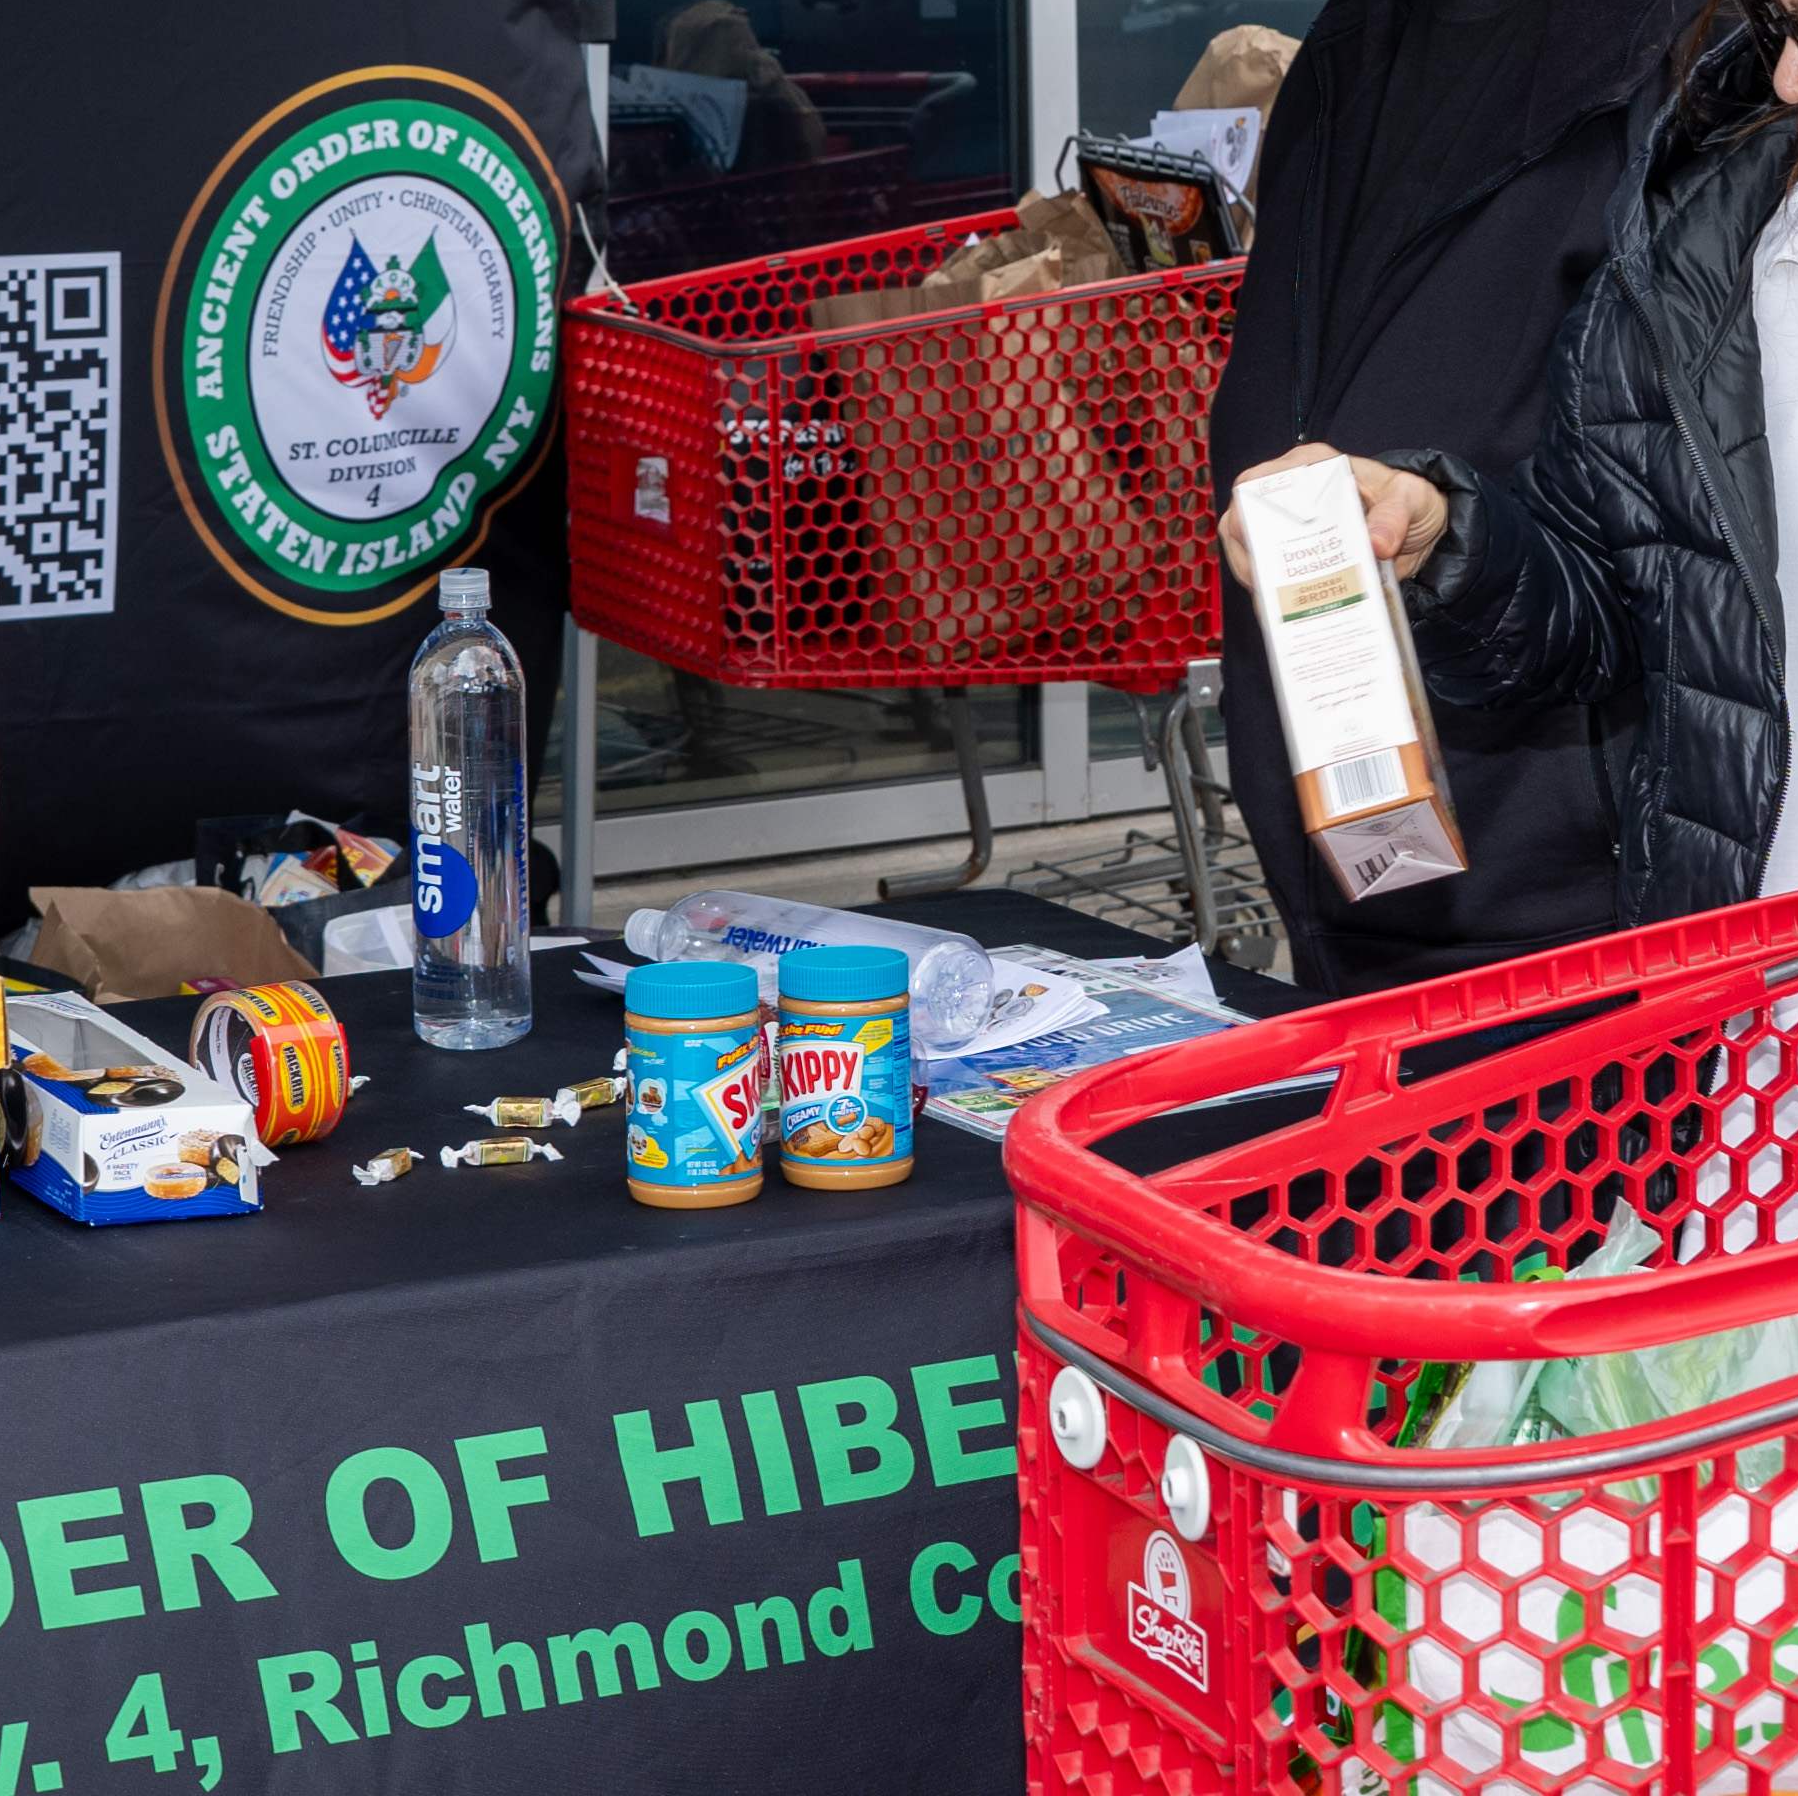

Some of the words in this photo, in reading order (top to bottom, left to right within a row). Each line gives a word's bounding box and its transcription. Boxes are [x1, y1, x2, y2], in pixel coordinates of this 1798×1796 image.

[196, 195, 271, 400] ANCIENT
[270, 119, 400, 199] ORDER
[408, 119, 459, 154] OF
[458, 136, 559, 373] HIBERNIANS
[263, 232, 318, 357] FRIENDSHIP
[329, 190, 385, 229] UNITY
[400, 189, 485, 251] CHRISTIAN
[478, 250, 505, 339] CHARITY
[289, 441, 320, 462] ST.
[326, 428, 460, 457] COLUMCILLE
[206, 425, 342, 574] STATEN
[339, 471, 478, 576] ISLAND
[484, 395, 536, 471] NY
[329, 456, 417, 483] DIVISION
[366, 483, 381, 508] 4
[1296, 583, 1349, 606] BROTH
[441, 765, 463, 834] water
[412, 760, 443, 915] smart
[804, 1023, 844, 1036] FUN!
[1091, 1012, 1195, 1037] DRIVE
[282, 1045, 305, 1108] PACKRITE
[781, 1050, 858, 1102] KIPPY
[99, 1115, 168, 1151] Entenmann's
[786, 1105, 822, 1130] CREAMY
[112, 1136, 169, 1159] CLASSIC
[112, 1163, 138, 1171] VARIETY
[325, 1425, 550, 1582] OF
[1135, 1604, 1203, 1666] ShopRite
[104, 1672, 224, 1793] 4,
[256, 1558, 875, 1755] Richmond
